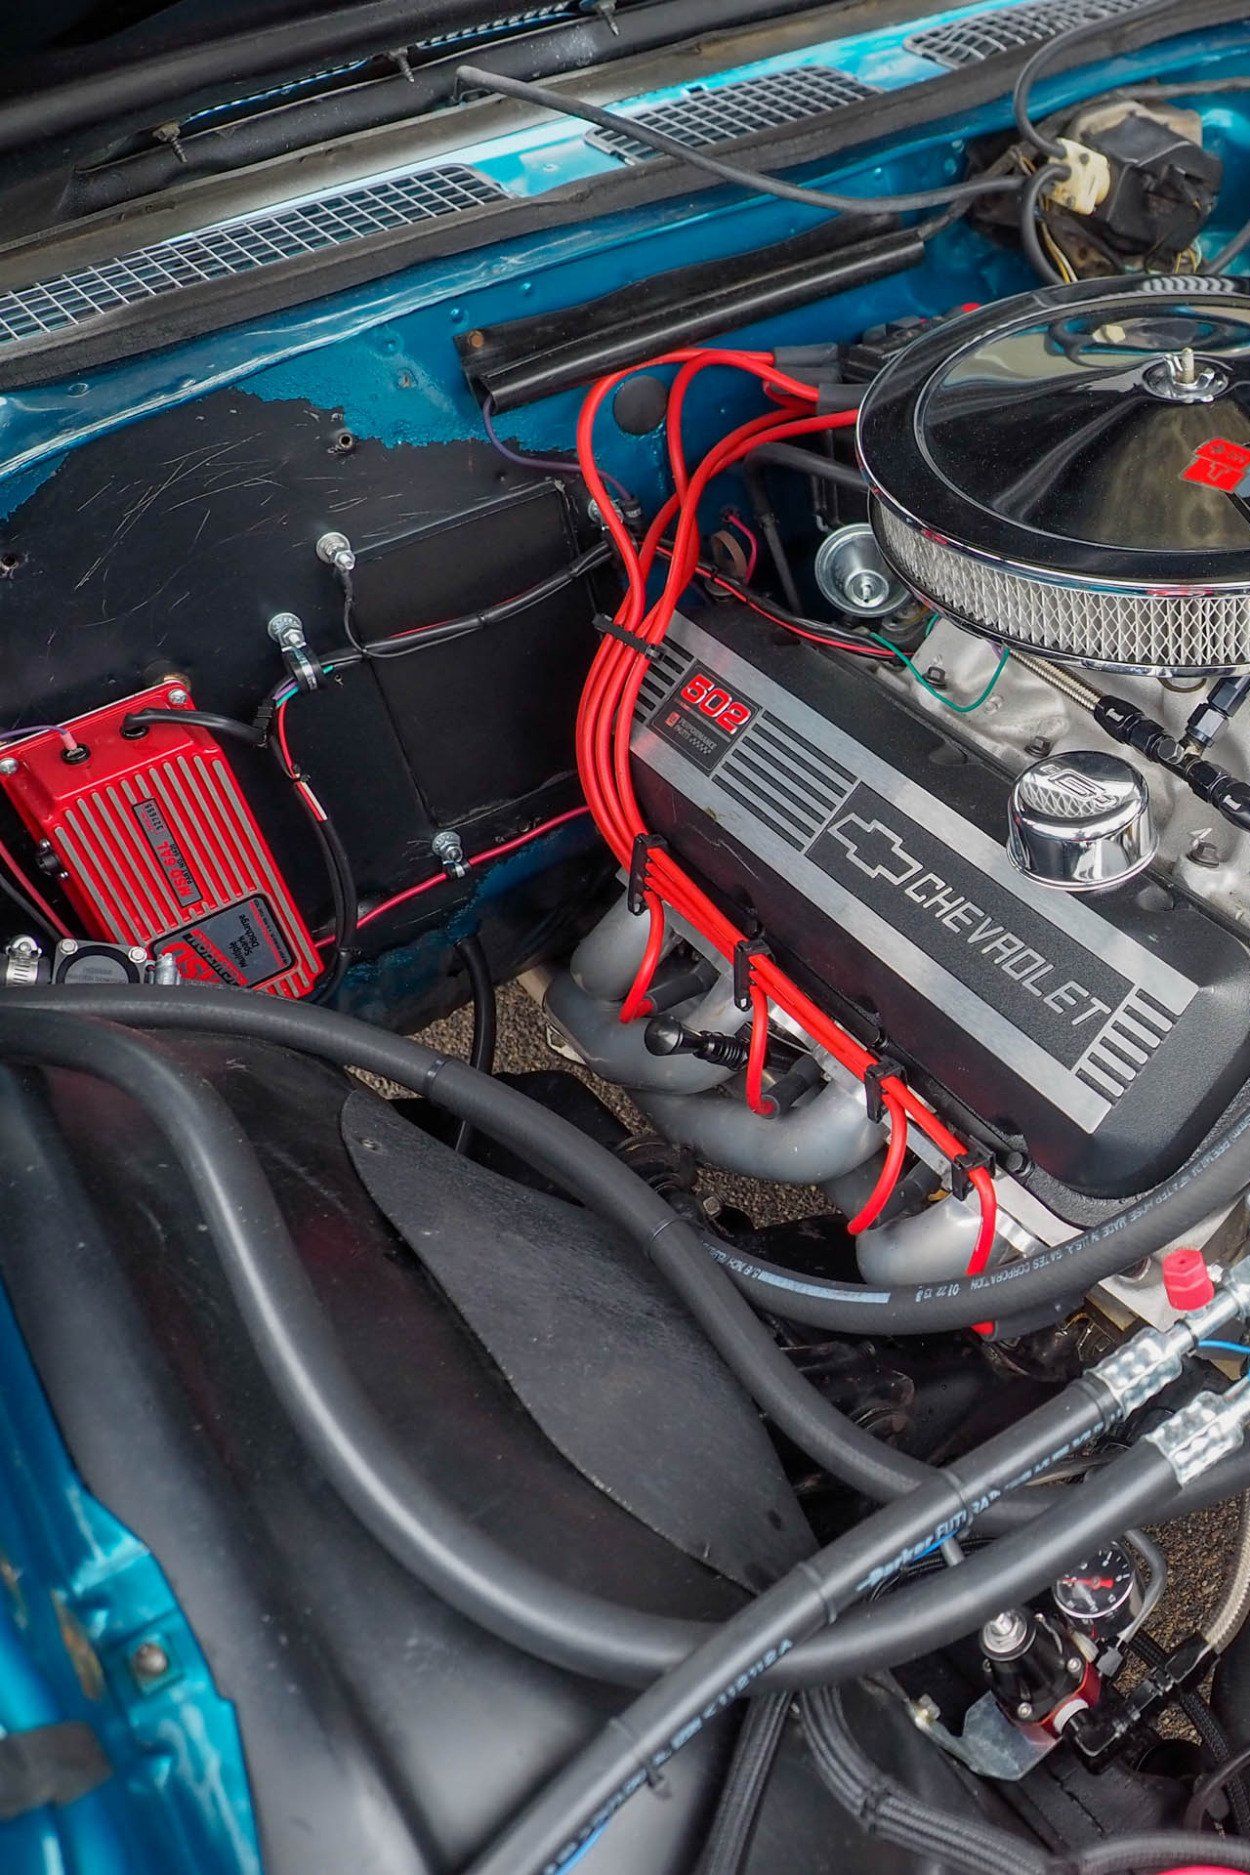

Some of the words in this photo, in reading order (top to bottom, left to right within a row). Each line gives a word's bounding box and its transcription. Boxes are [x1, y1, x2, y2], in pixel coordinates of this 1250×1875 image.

[680, 673, 752, 735] 502
[238, 913, 260, 948] Discharge
[904, 872, 1112, 1027] CHEVROLET
[1033, 1250, 1063, 1271] GATES
[970, 1266, 1031, 1291] CORPORATION
